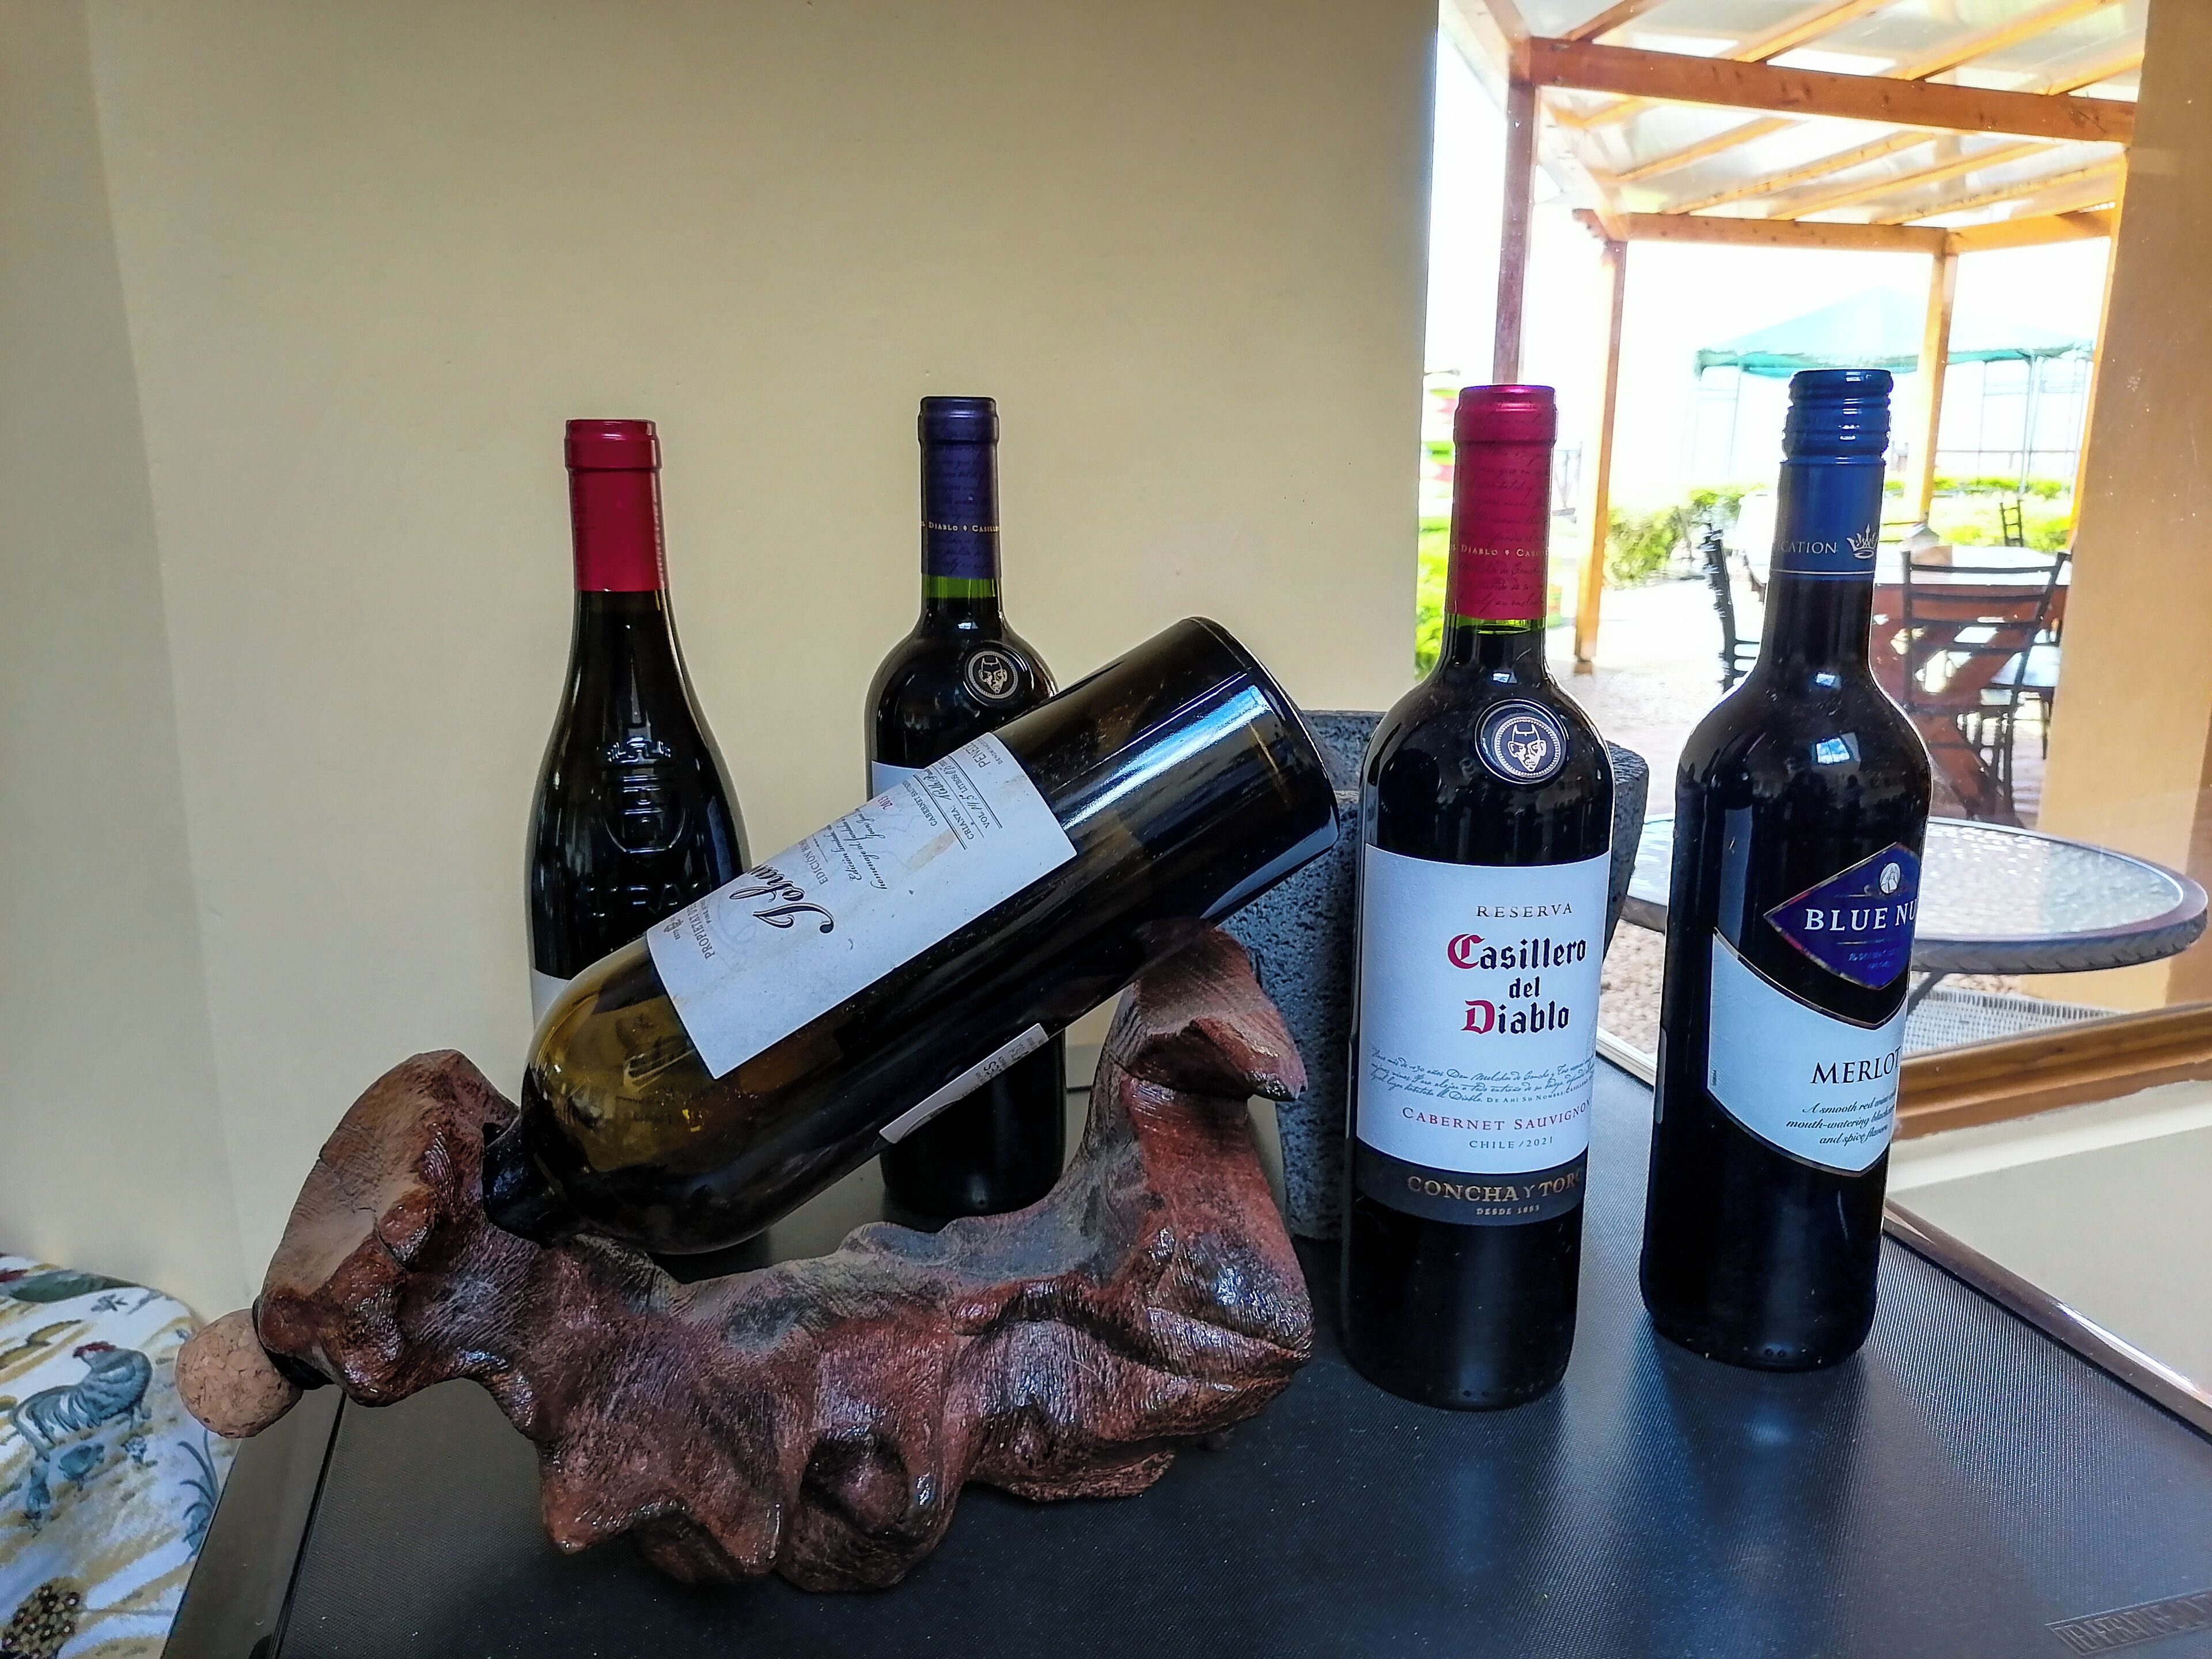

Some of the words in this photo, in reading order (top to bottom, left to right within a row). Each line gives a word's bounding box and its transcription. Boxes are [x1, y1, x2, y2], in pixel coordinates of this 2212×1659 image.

[877, 796, 893, 810] 2013
[1476, 902, 1573, 918] RESERVA
[1804, 907, 1888, 931] BLUE
[1447, 933, 1587, 970] Casillero
[1509, 976, 1540, 999] del
[1460, 999, 1570, 1035] Diablo
[1809, 1046, 1902, 1084] MERLOT
[1402, 1107, 1505, 1130] CABERNET
[1514, 1099, 1591, 1130] SAUVIGNON
[1802, 1103, 1820, 1113] A
[1819, 1101, 1858, 1114] smooth
[1858, 1097, 1876, 1111] red
[1786, 1118, 1870, 1129] mouth-watering
[1819, 1132, 1843, 1144] and
[1842, 1132, 1866, 1147] spice
[1407, 1176, 1520, 1203] CONCHA
[1523, 1185, 1536, 1199] Y
[1476, 1207, 1512, 1215] DESDE
